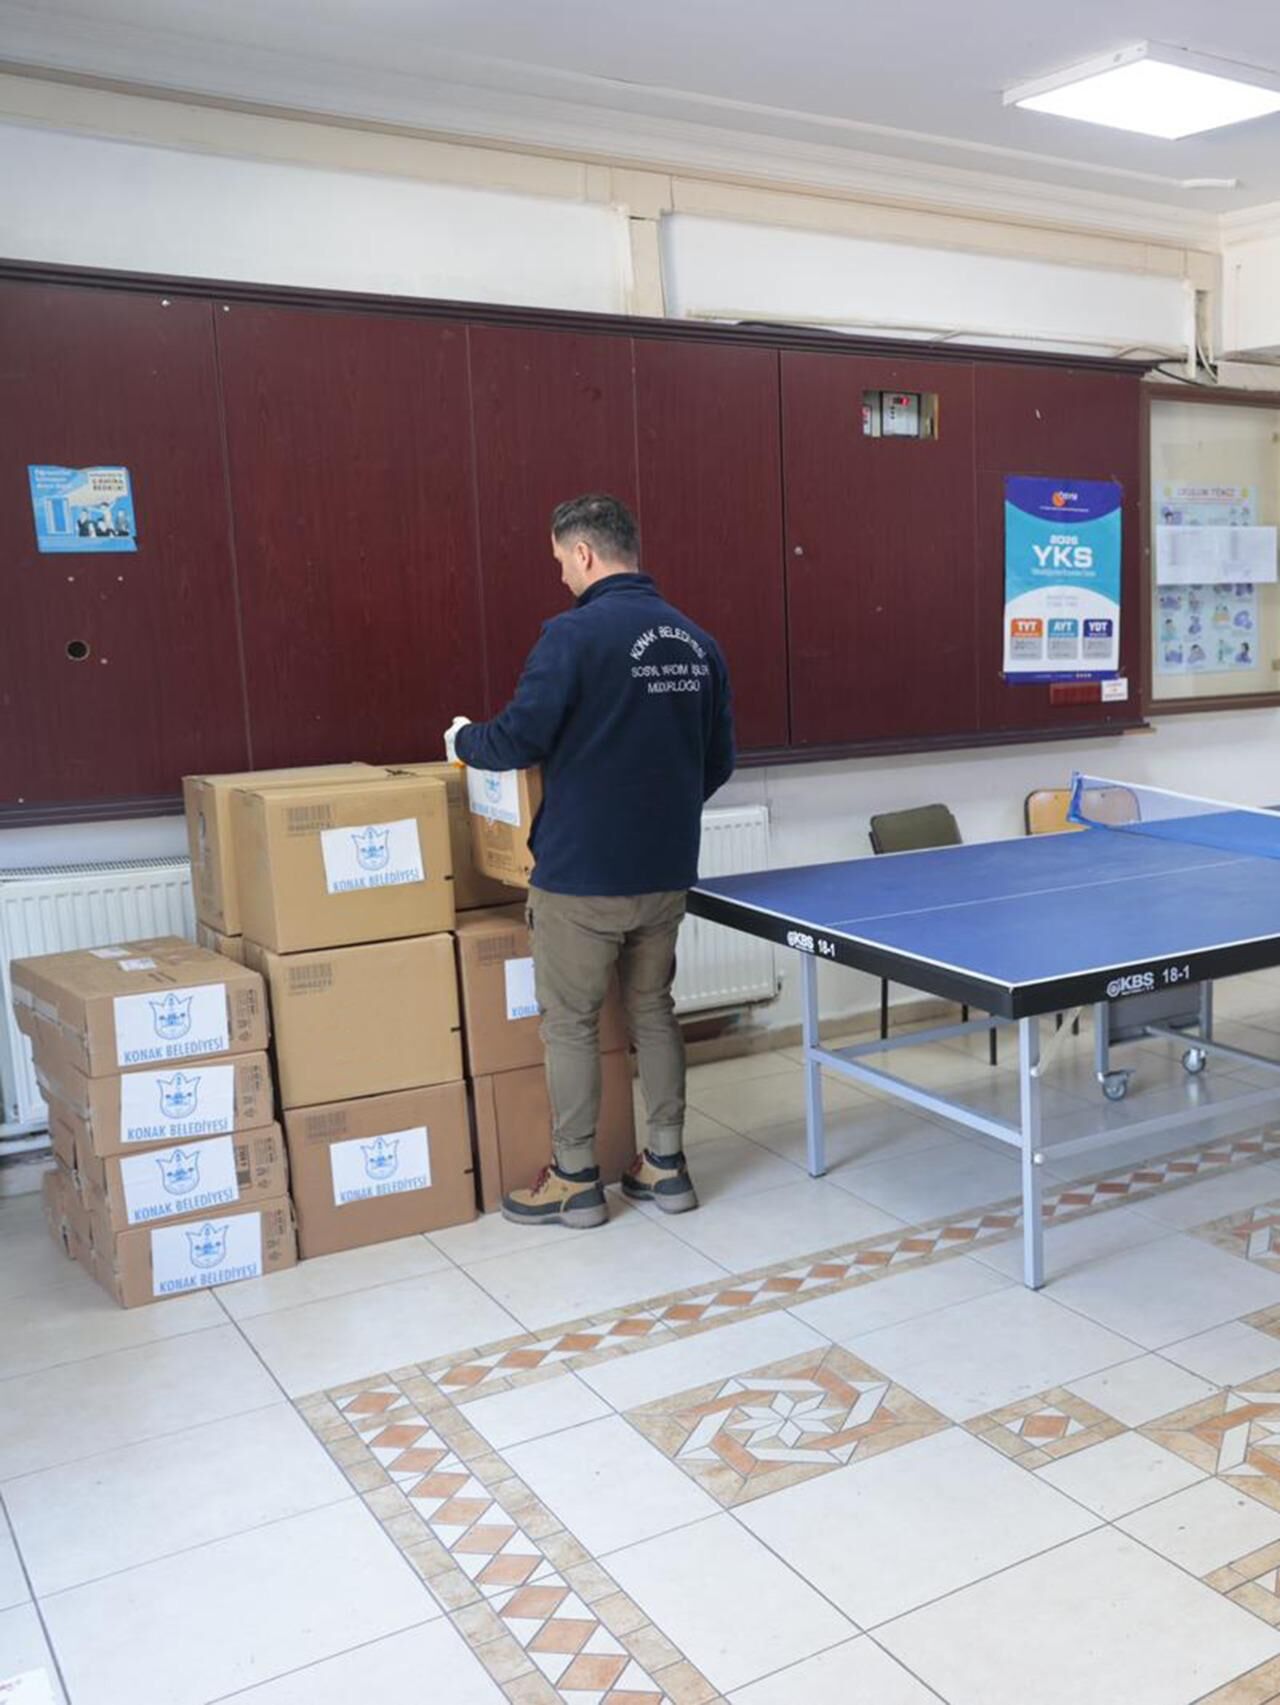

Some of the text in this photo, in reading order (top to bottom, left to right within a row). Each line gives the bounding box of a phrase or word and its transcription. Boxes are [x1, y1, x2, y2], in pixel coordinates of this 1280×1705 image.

[1032, 544, 1093, 568] YKS
[1018, 621, 1037, 632] TYT
[1053, 621, 1072, 632] AYT
[1088, 621, 1108, 632] YDT
[629, 629, 658, 661] KONAK
[333, 876, 366, 892] KONAK
[818, 938, 835, 957] 18-1
[1162, 964, 1190, 984] 18-1
[512, 1002, 537, 1018] KONA
[124, 1036, 224, 1063] KONAK BELEDİYESİ
[127, 1117, 229, 1141] KONAK BELEDİYESİ
[134, 1188, 233, 1221] KONAK BELEDİYESİ
[159, 1263, 257, 1292] KONAK BELEDİYESİ
